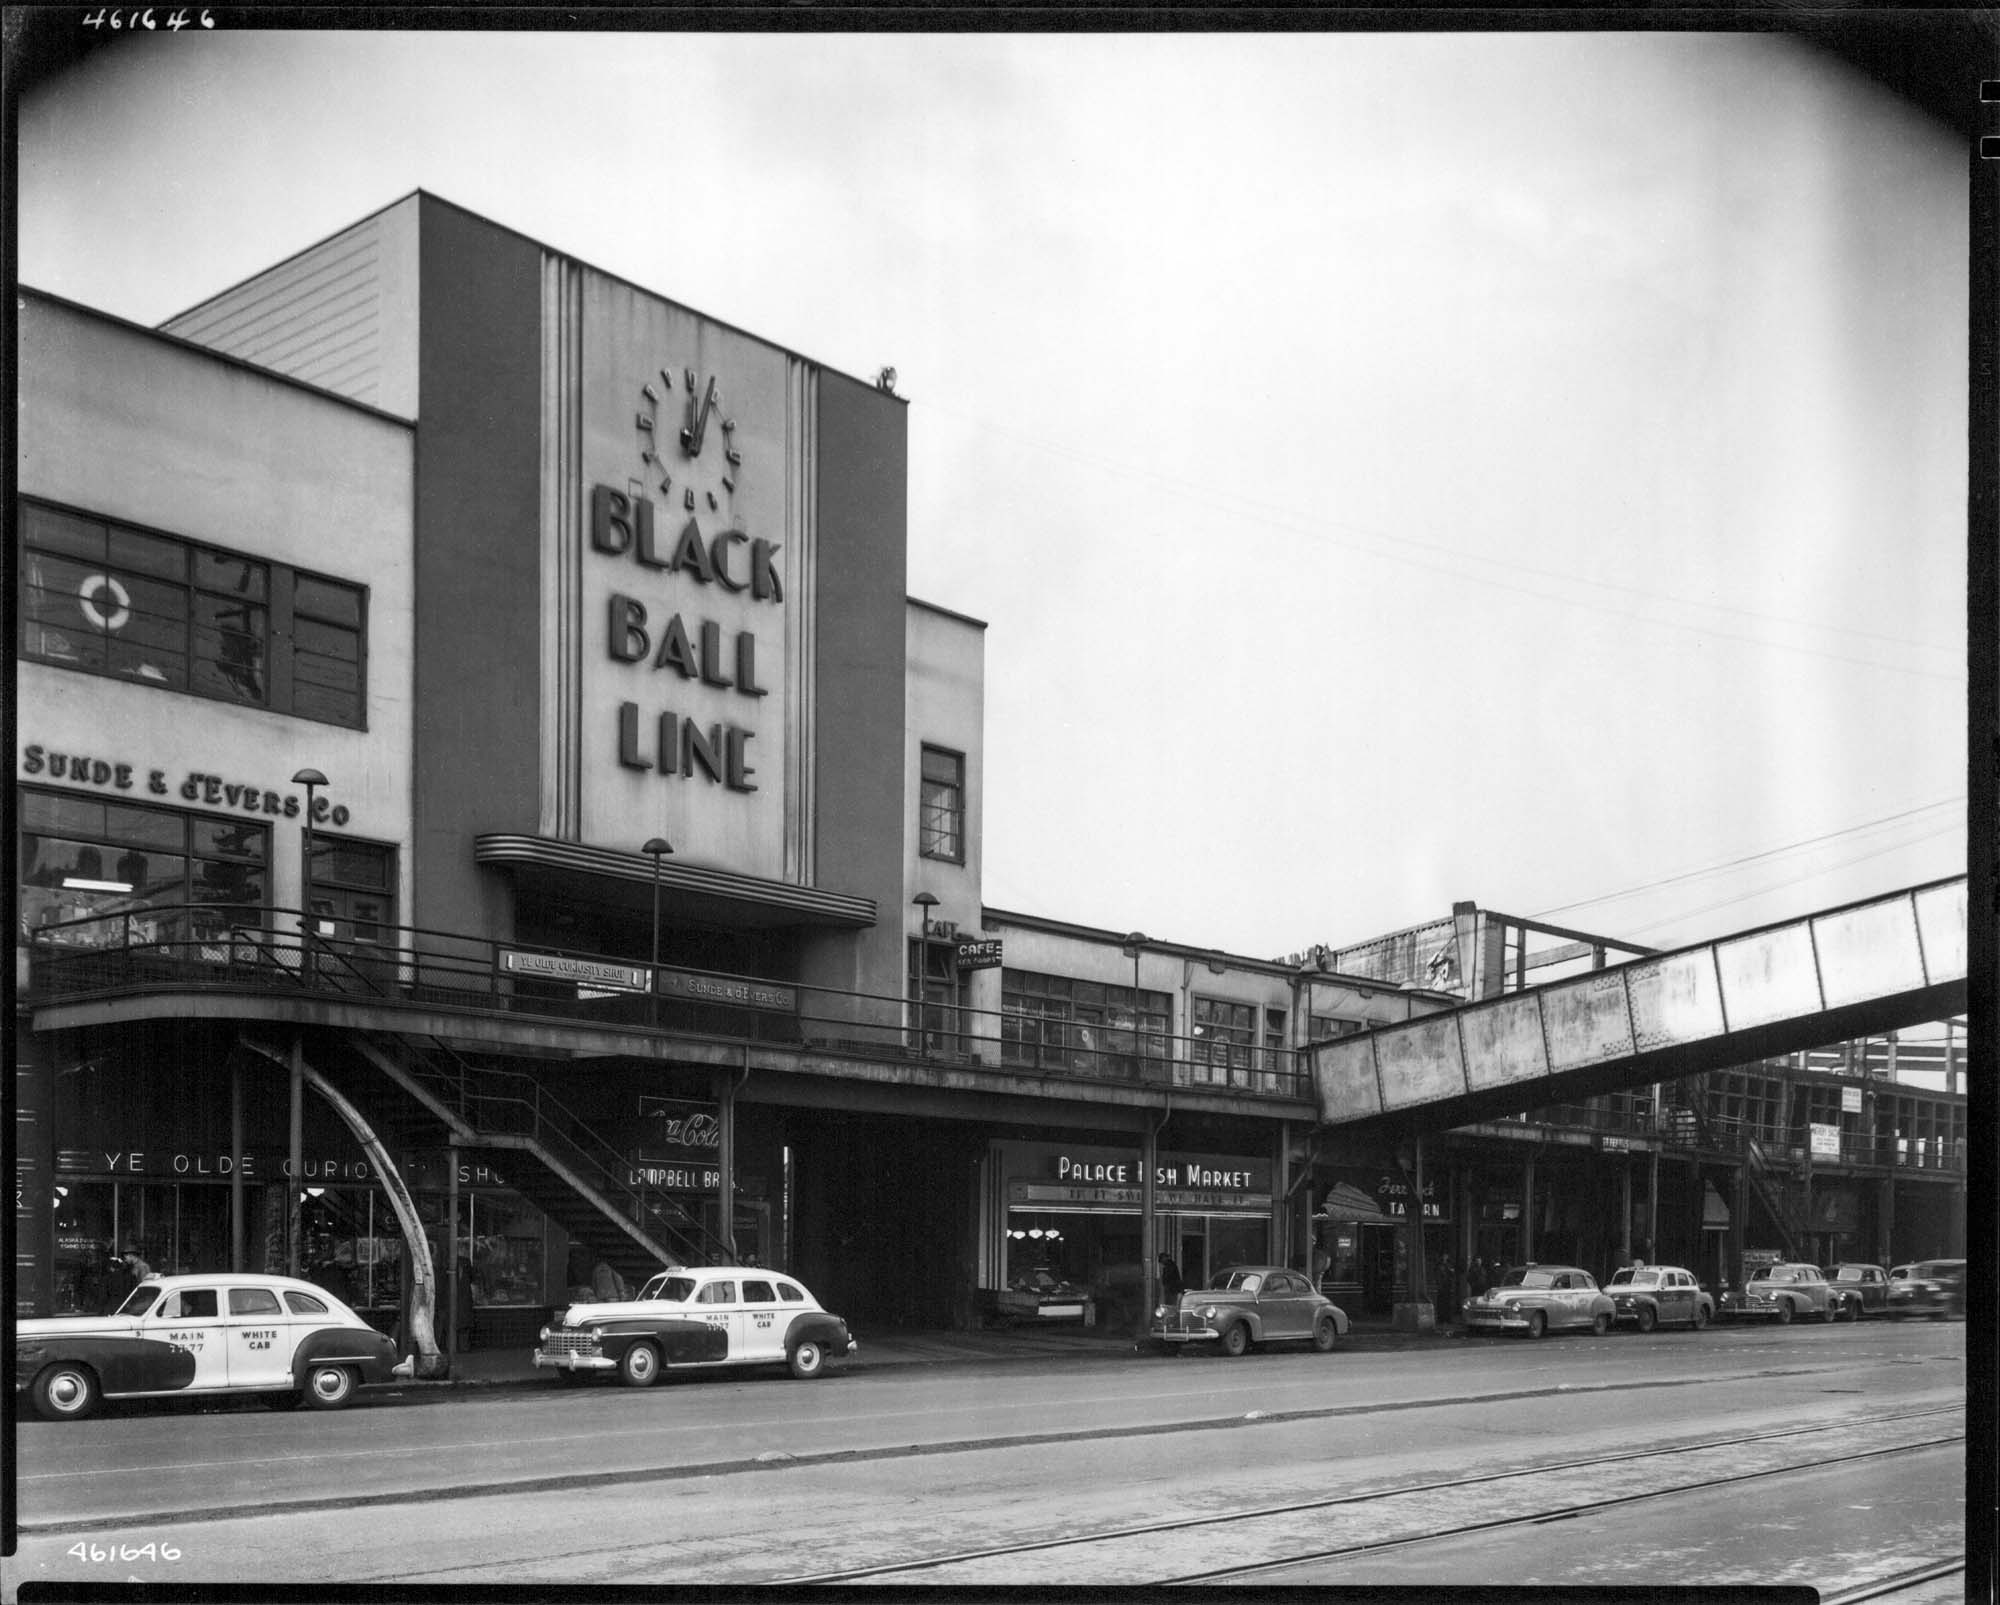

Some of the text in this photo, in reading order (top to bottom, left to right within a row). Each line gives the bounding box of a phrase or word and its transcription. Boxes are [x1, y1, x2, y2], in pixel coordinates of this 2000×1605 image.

[591, 482, 784, 604] BLACK
[608, 592, 769, 697] BALL
[619, 701, 759, 792] LINE
[23, 744, 134, 790] SUNDE
[148, 769, 169, 795] &
[959, 942, 995, 956] CAFE
[603, 966, 626, 980] SHOP
[104, 1152, 144, 1172] YE
[173, 1154, 256, 1175] OLDE
[1058, 1156, 1128, 1183] PALACE
[1186, 1164, 1252, 1188] MARKET
[752, 1312, 775, 1320] WHITE
[169, 1331, 205, 1341] MAIN
[241, 1330, 278, 1339] WHITE
[248, 1341, 271, 1350] CAB
